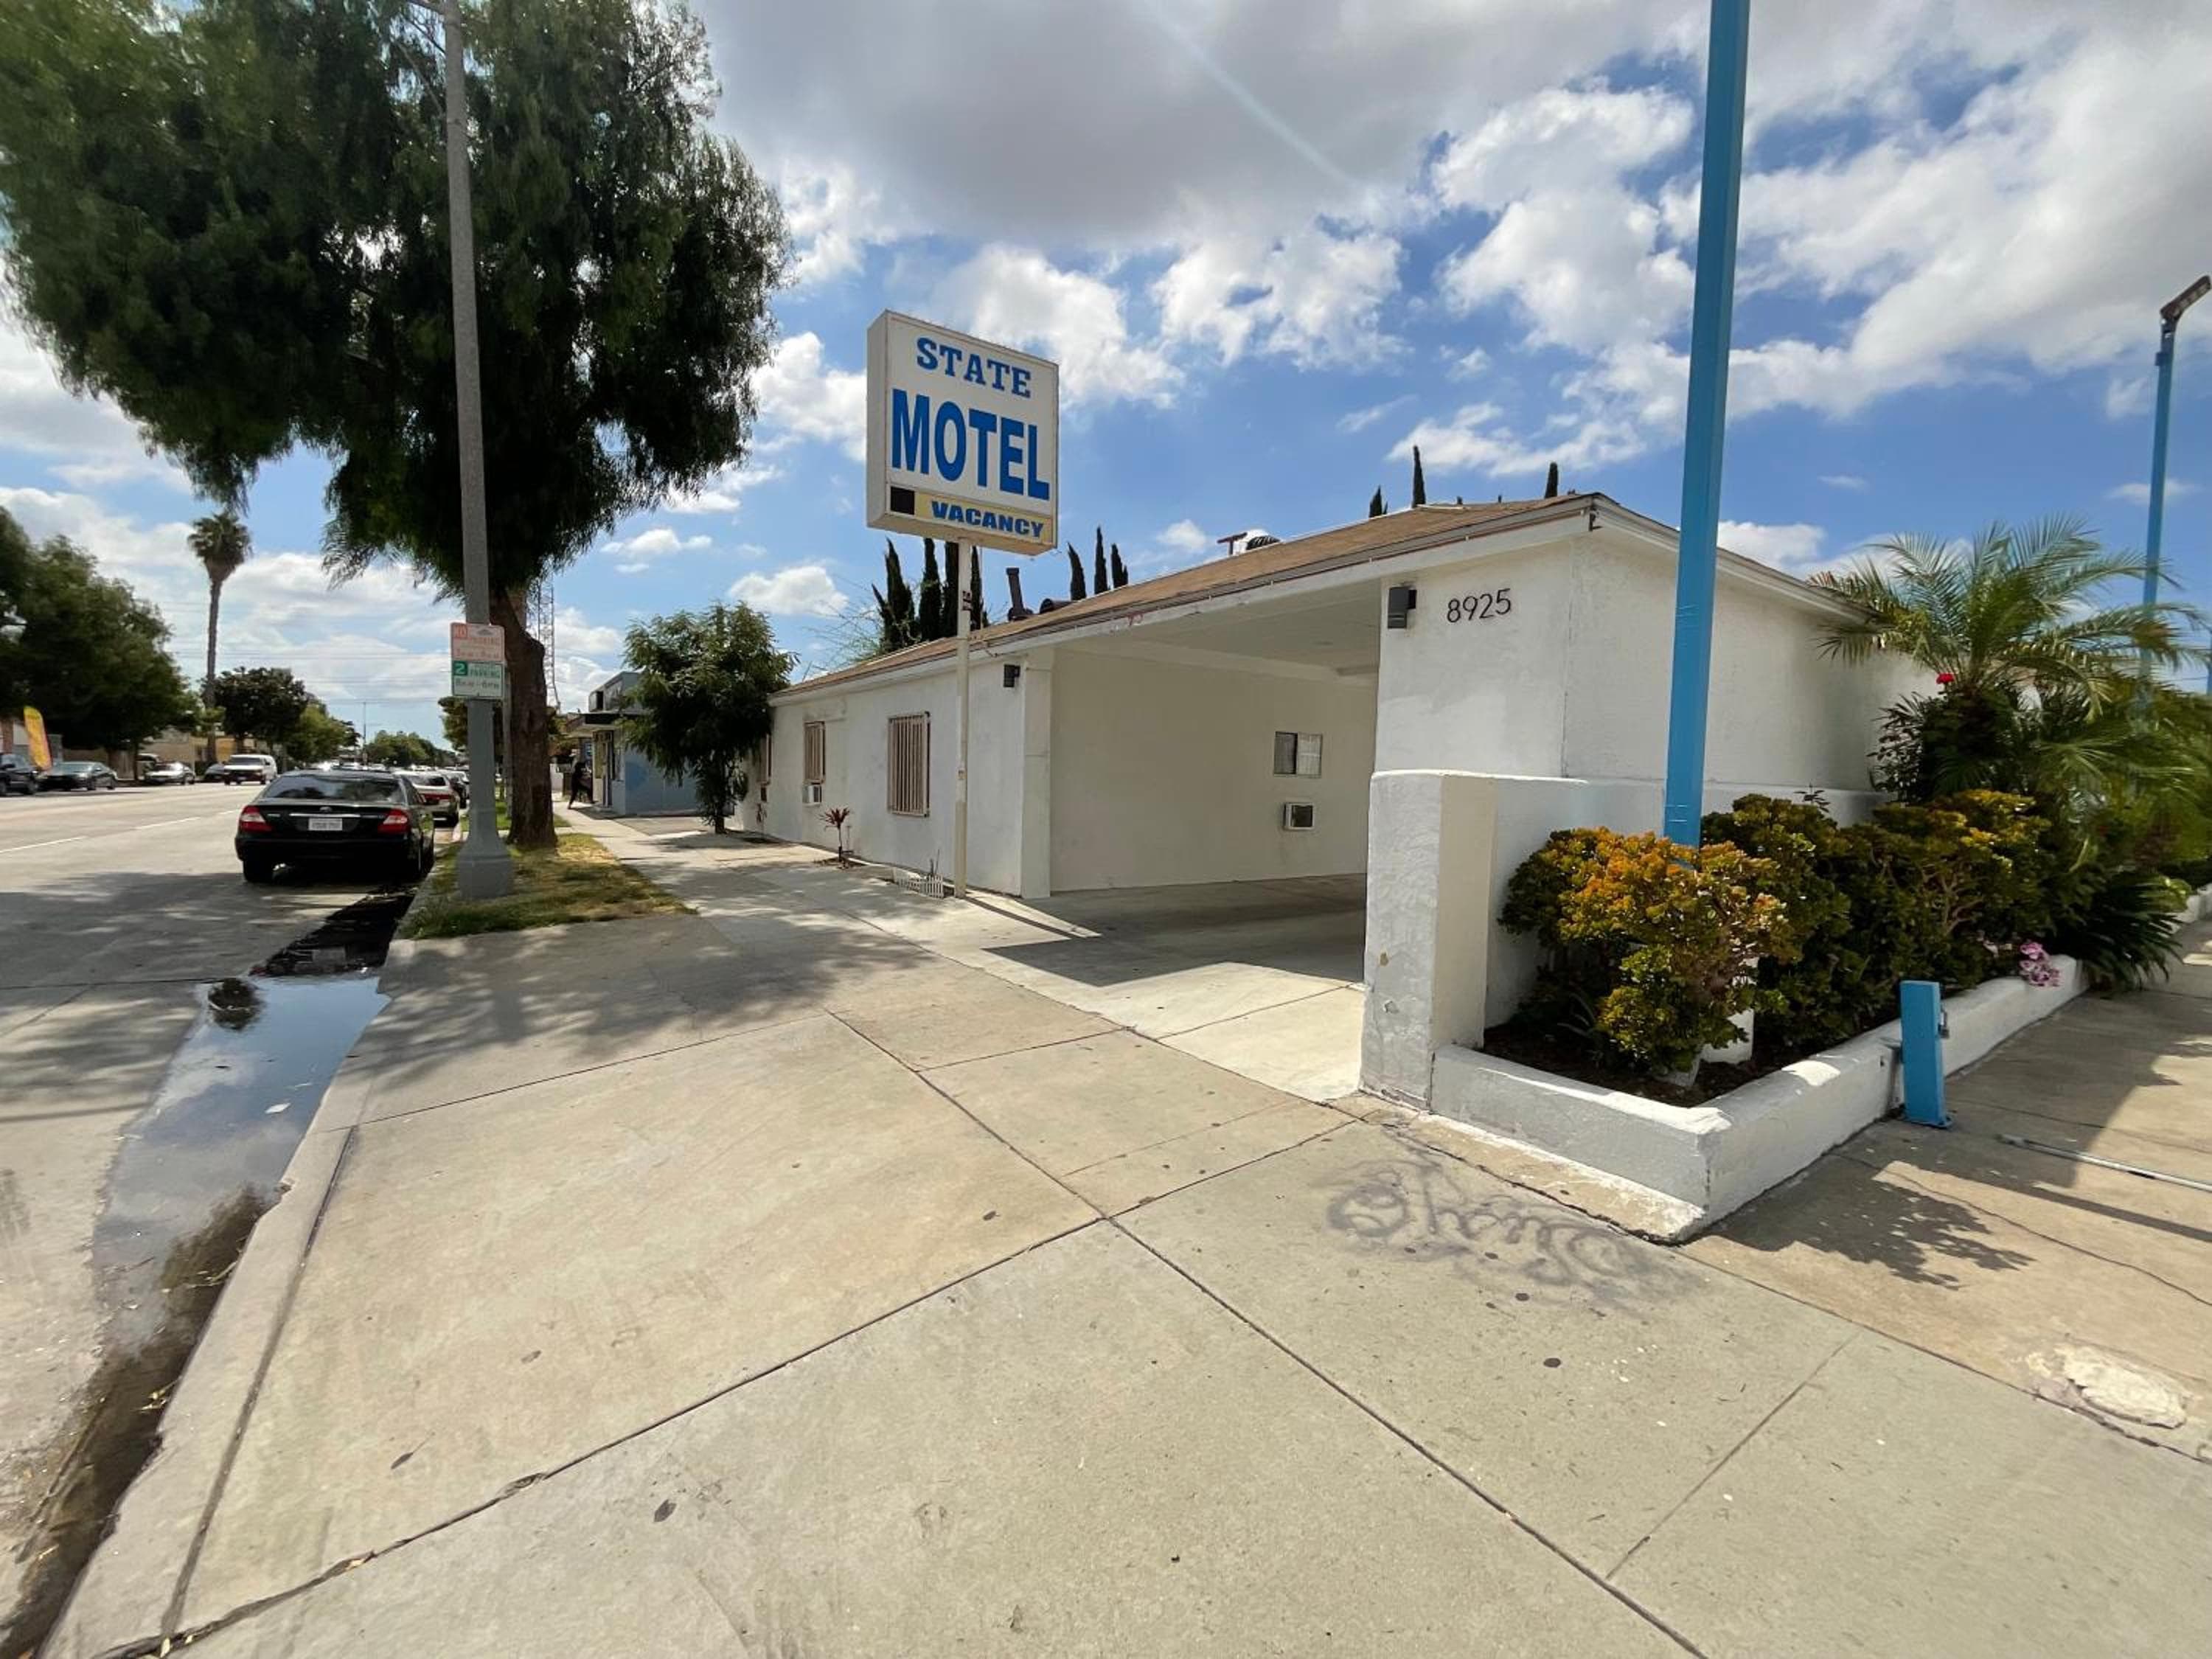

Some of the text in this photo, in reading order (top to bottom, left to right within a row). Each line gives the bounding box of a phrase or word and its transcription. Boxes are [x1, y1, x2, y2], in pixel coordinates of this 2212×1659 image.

[917, 338, 1031, 398] STATE
[892, 389, 1050, 501] MOTEL
[932, 501, 1044, 538] VACANCY
[1447, 588, 1512, 623] 8925
[454, 664, 465, 674] 2
